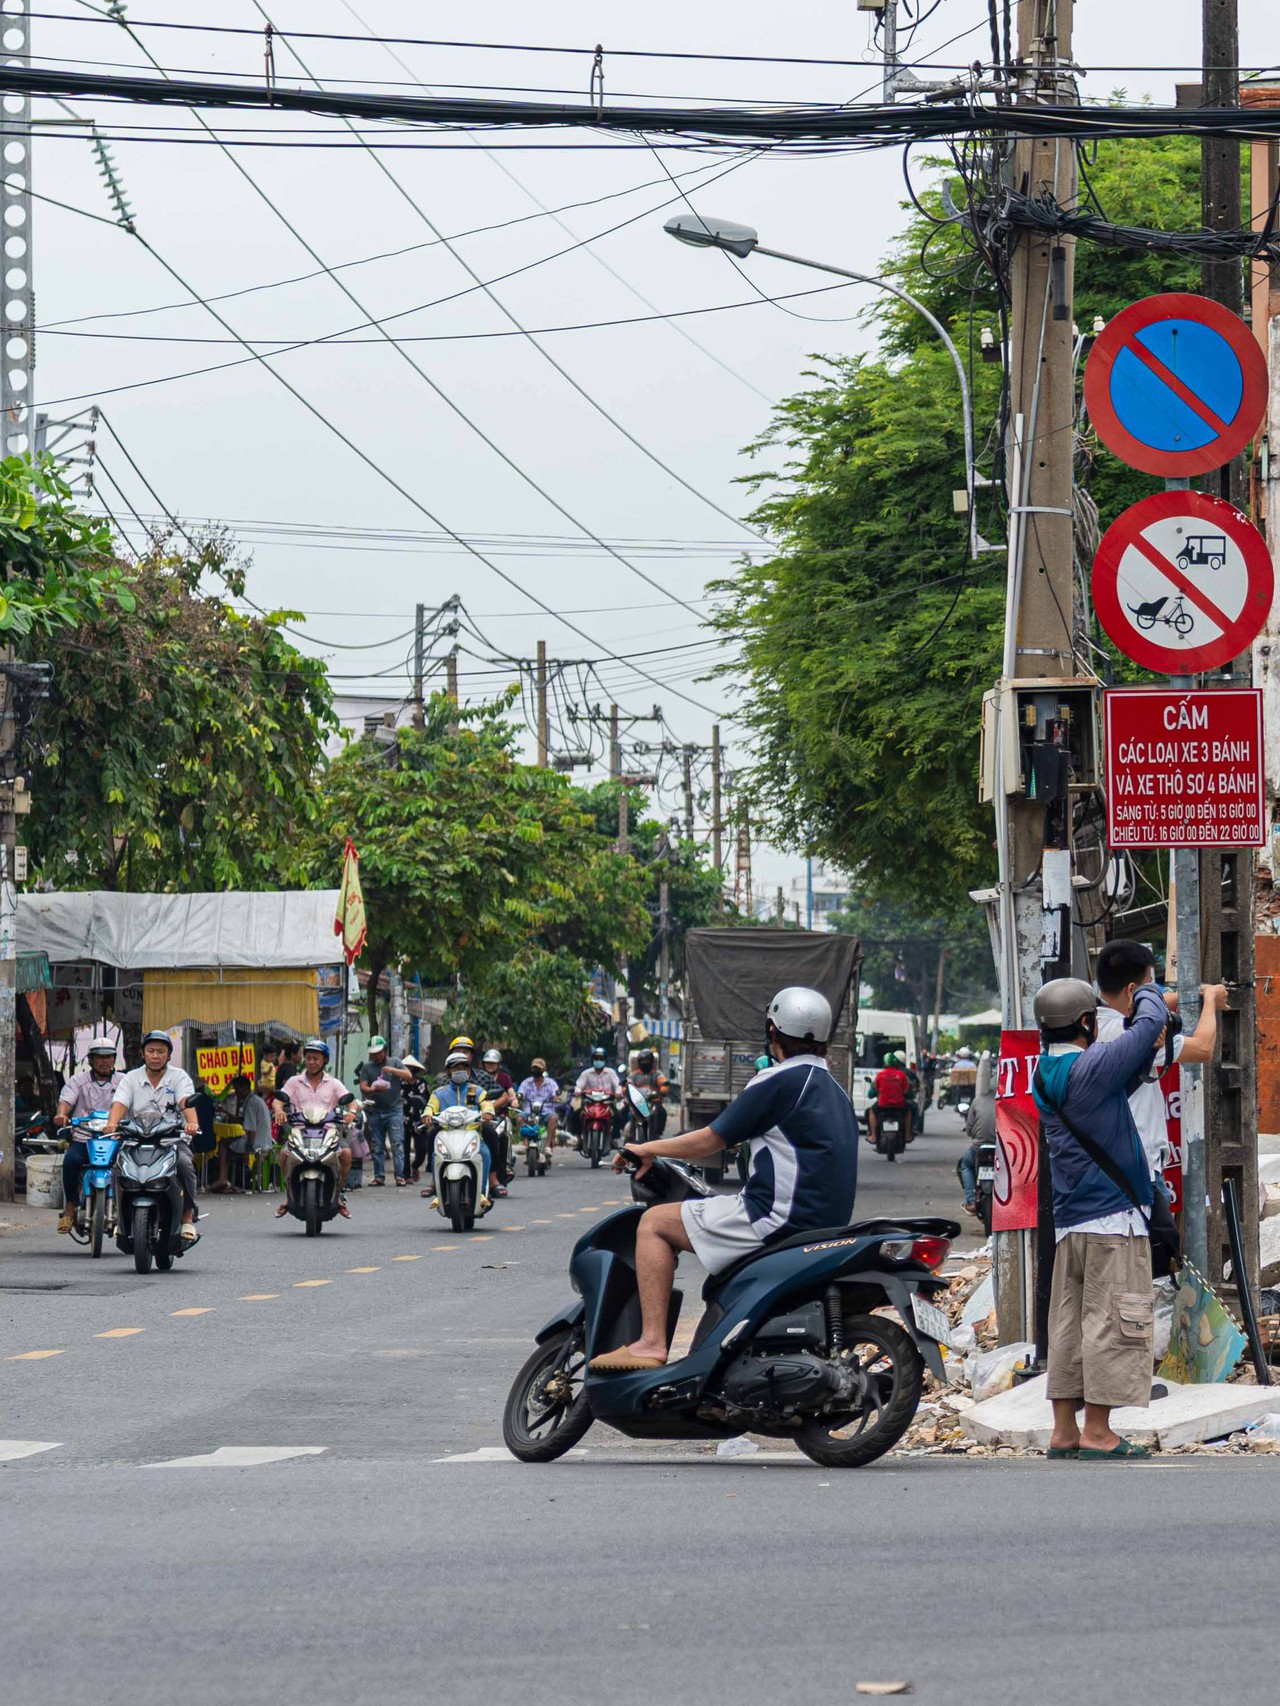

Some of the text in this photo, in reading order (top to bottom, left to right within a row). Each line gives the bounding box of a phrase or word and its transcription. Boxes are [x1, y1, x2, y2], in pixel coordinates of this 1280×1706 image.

[1163, 695, 1208, 730] CẤM
[1119, 735, 1250, 767] CÁC LOẠI XE 3 BÁNH
[1116, 766, 1256, 795] VÀ XE THÔ SƠ 4 BÁNH
[1116, 797, 1256, 820] SÁNG TỪ: 5 GIỜ 00 ĐẾN 13 GIỜ 00
[1113, 819, 1259, 841] CHIỀU TỪ: 16 GIỜ 00 ĐẾN 22 GIỜ 00
[803, 1238, 858, 1253] VISION
